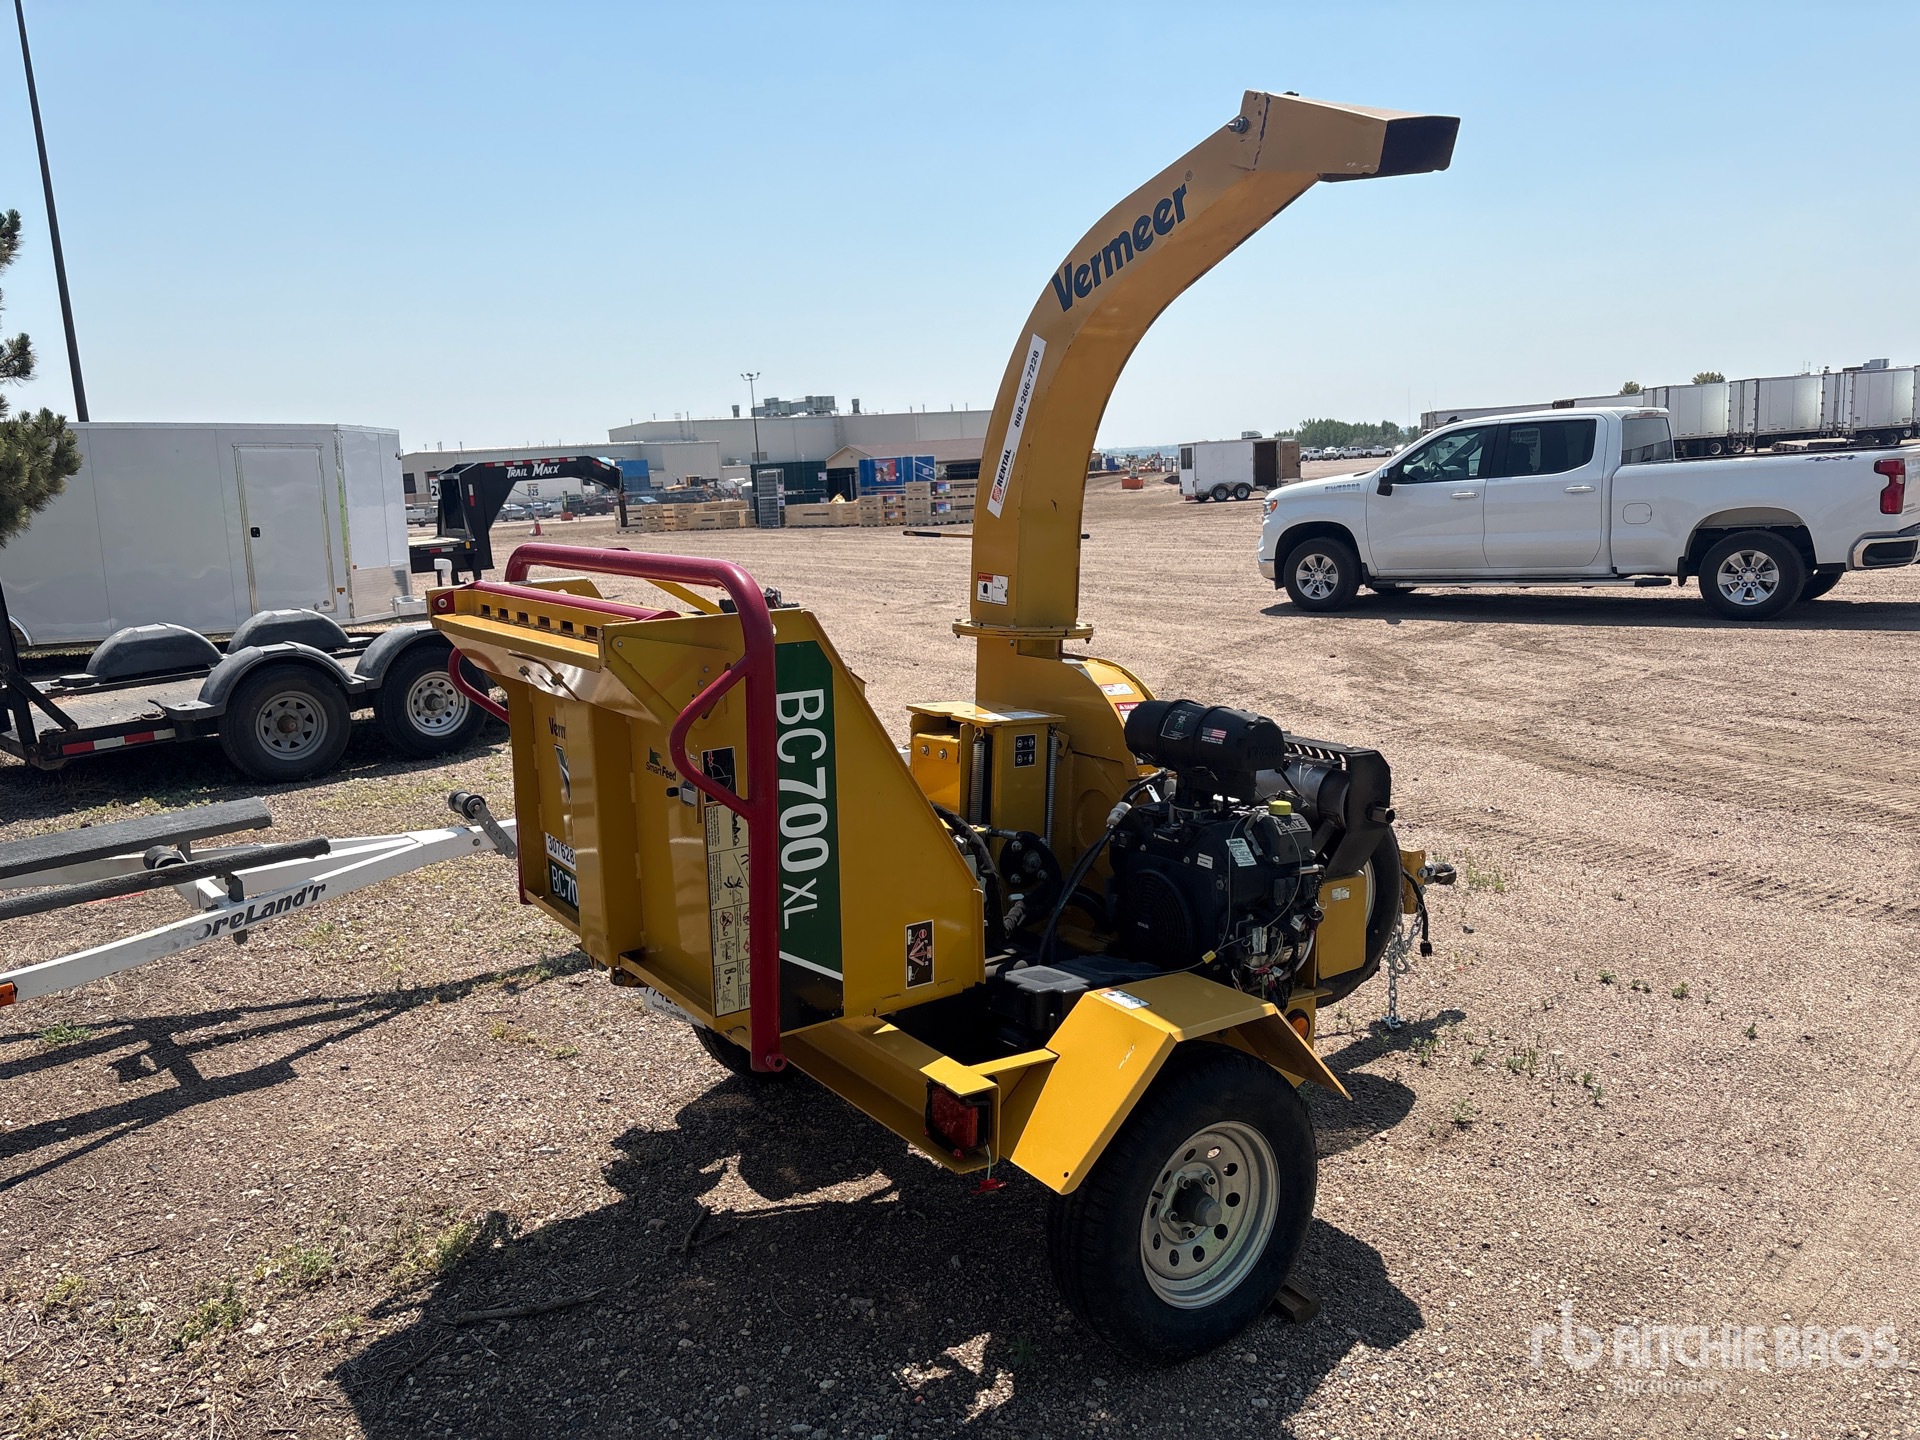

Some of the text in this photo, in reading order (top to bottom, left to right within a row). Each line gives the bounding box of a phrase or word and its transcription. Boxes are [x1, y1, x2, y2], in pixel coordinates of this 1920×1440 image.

[1051, 183, 1187, 312] Vermeer
[1014, 350, 1040, 428] 888-266-7228
[532, 462, 560, 477] MAXX
[996, 449, 1012, 488] RENTAL
